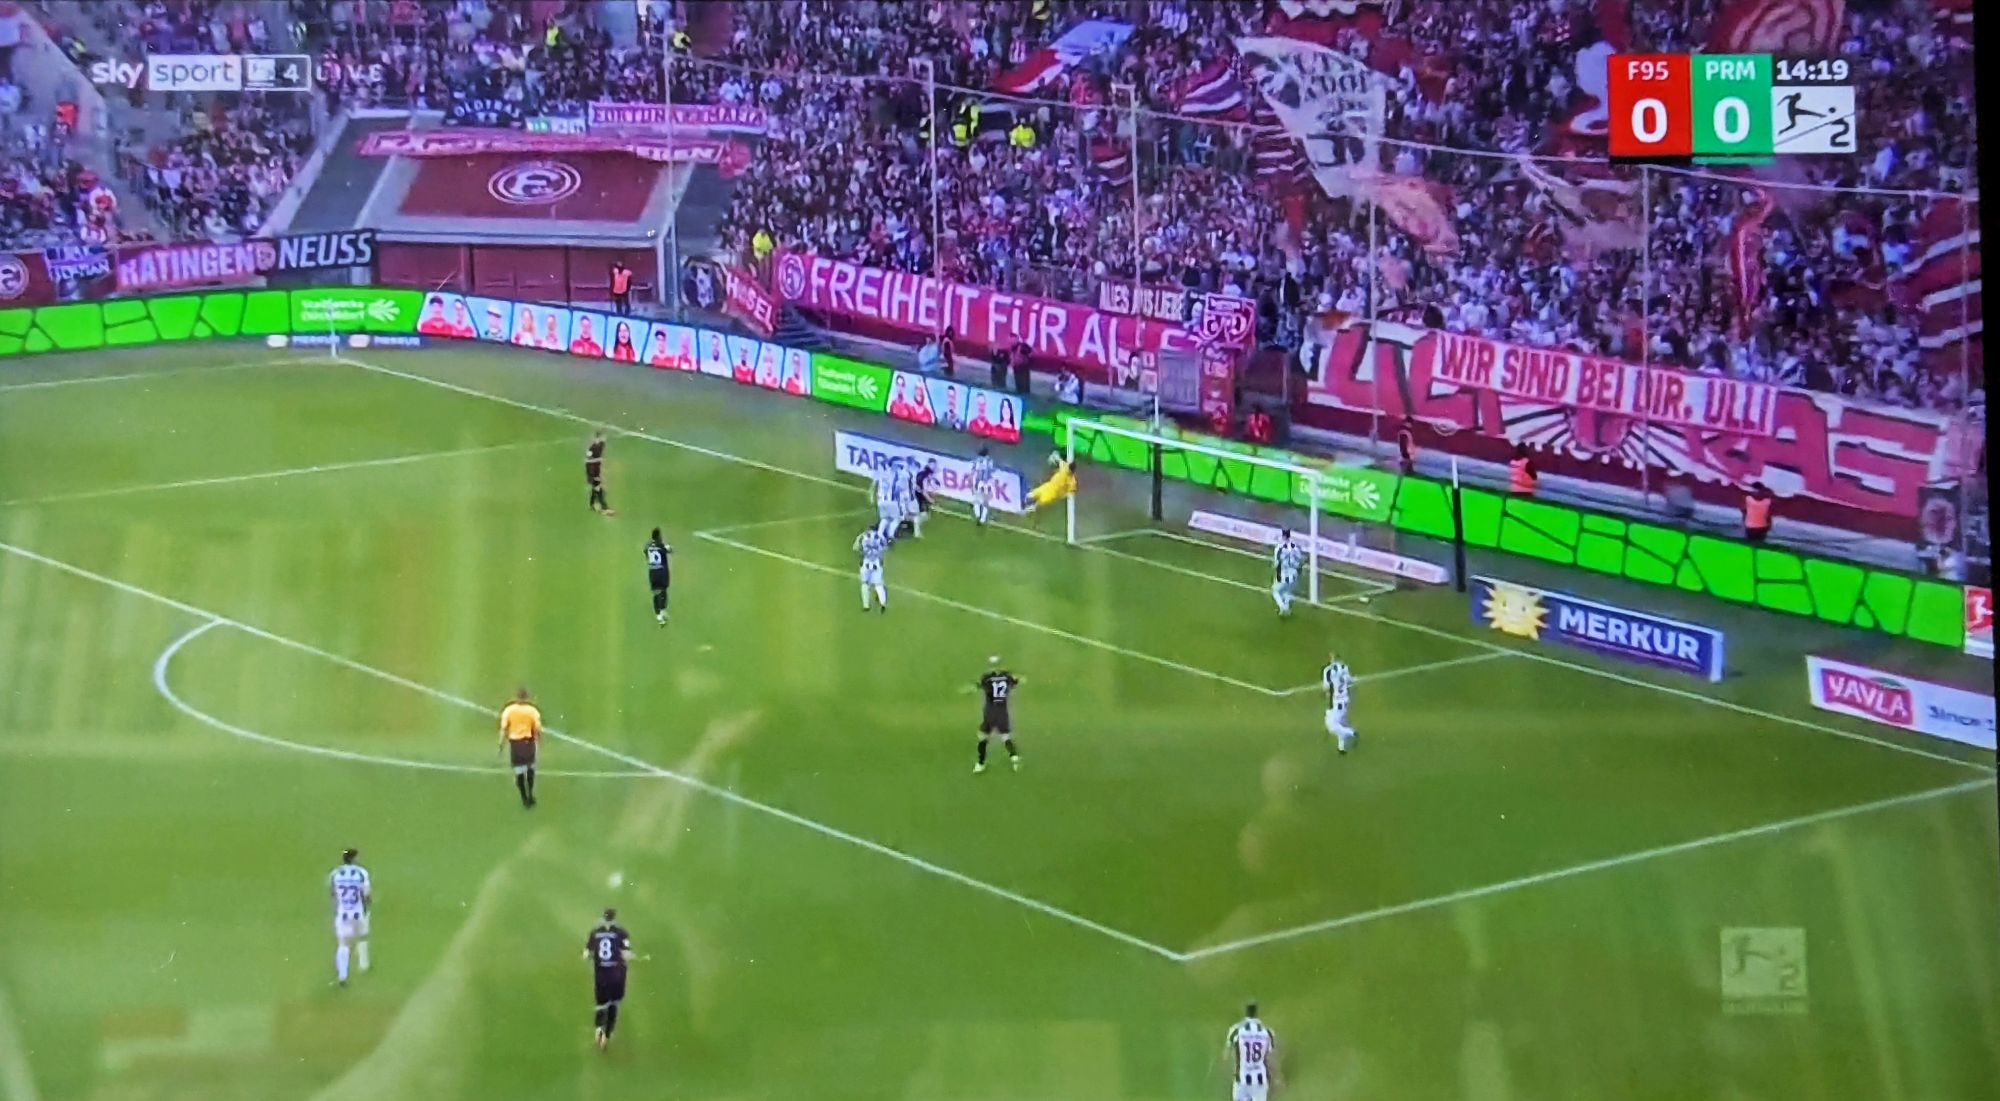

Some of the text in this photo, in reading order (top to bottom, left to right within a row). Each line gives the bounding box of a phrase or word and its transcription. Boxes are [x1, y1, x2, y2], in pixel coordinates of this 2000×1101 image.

[92, 58, 144, 88] sky
[155, 60, 234, 86] sport
[284, 64, 299, 83] 4
[1627, 61, 1669, 82] F95
[1705, 60, 1756, 82] PRM
[1776, 59, 1849, 81] 14:19
[1631, 97, 1668, 143] 0
[1713, 96, 1750, 143] 0
[1830, 117, 1850, 147] 2
[279, 232, 372, 270] NEUSS
[810, 257, 979, 338] FREIHEIT
[988, 295, 1067, 356] FÜR
[1440, 334, 1496, 385] WIR
[1501, 348, 1571, 400] SIND
[1576, 359, 1626, 410] BEI
[1704, 377, 1775, 436] ULLI
[1558, 603, 1700, 662] MERKUR
[992, 681, 1008, 698] 12
[339, 885, 358, 905] 23
[599, 938, 612, 960] 8
[1244, 1041, 1262, 1063] 18
